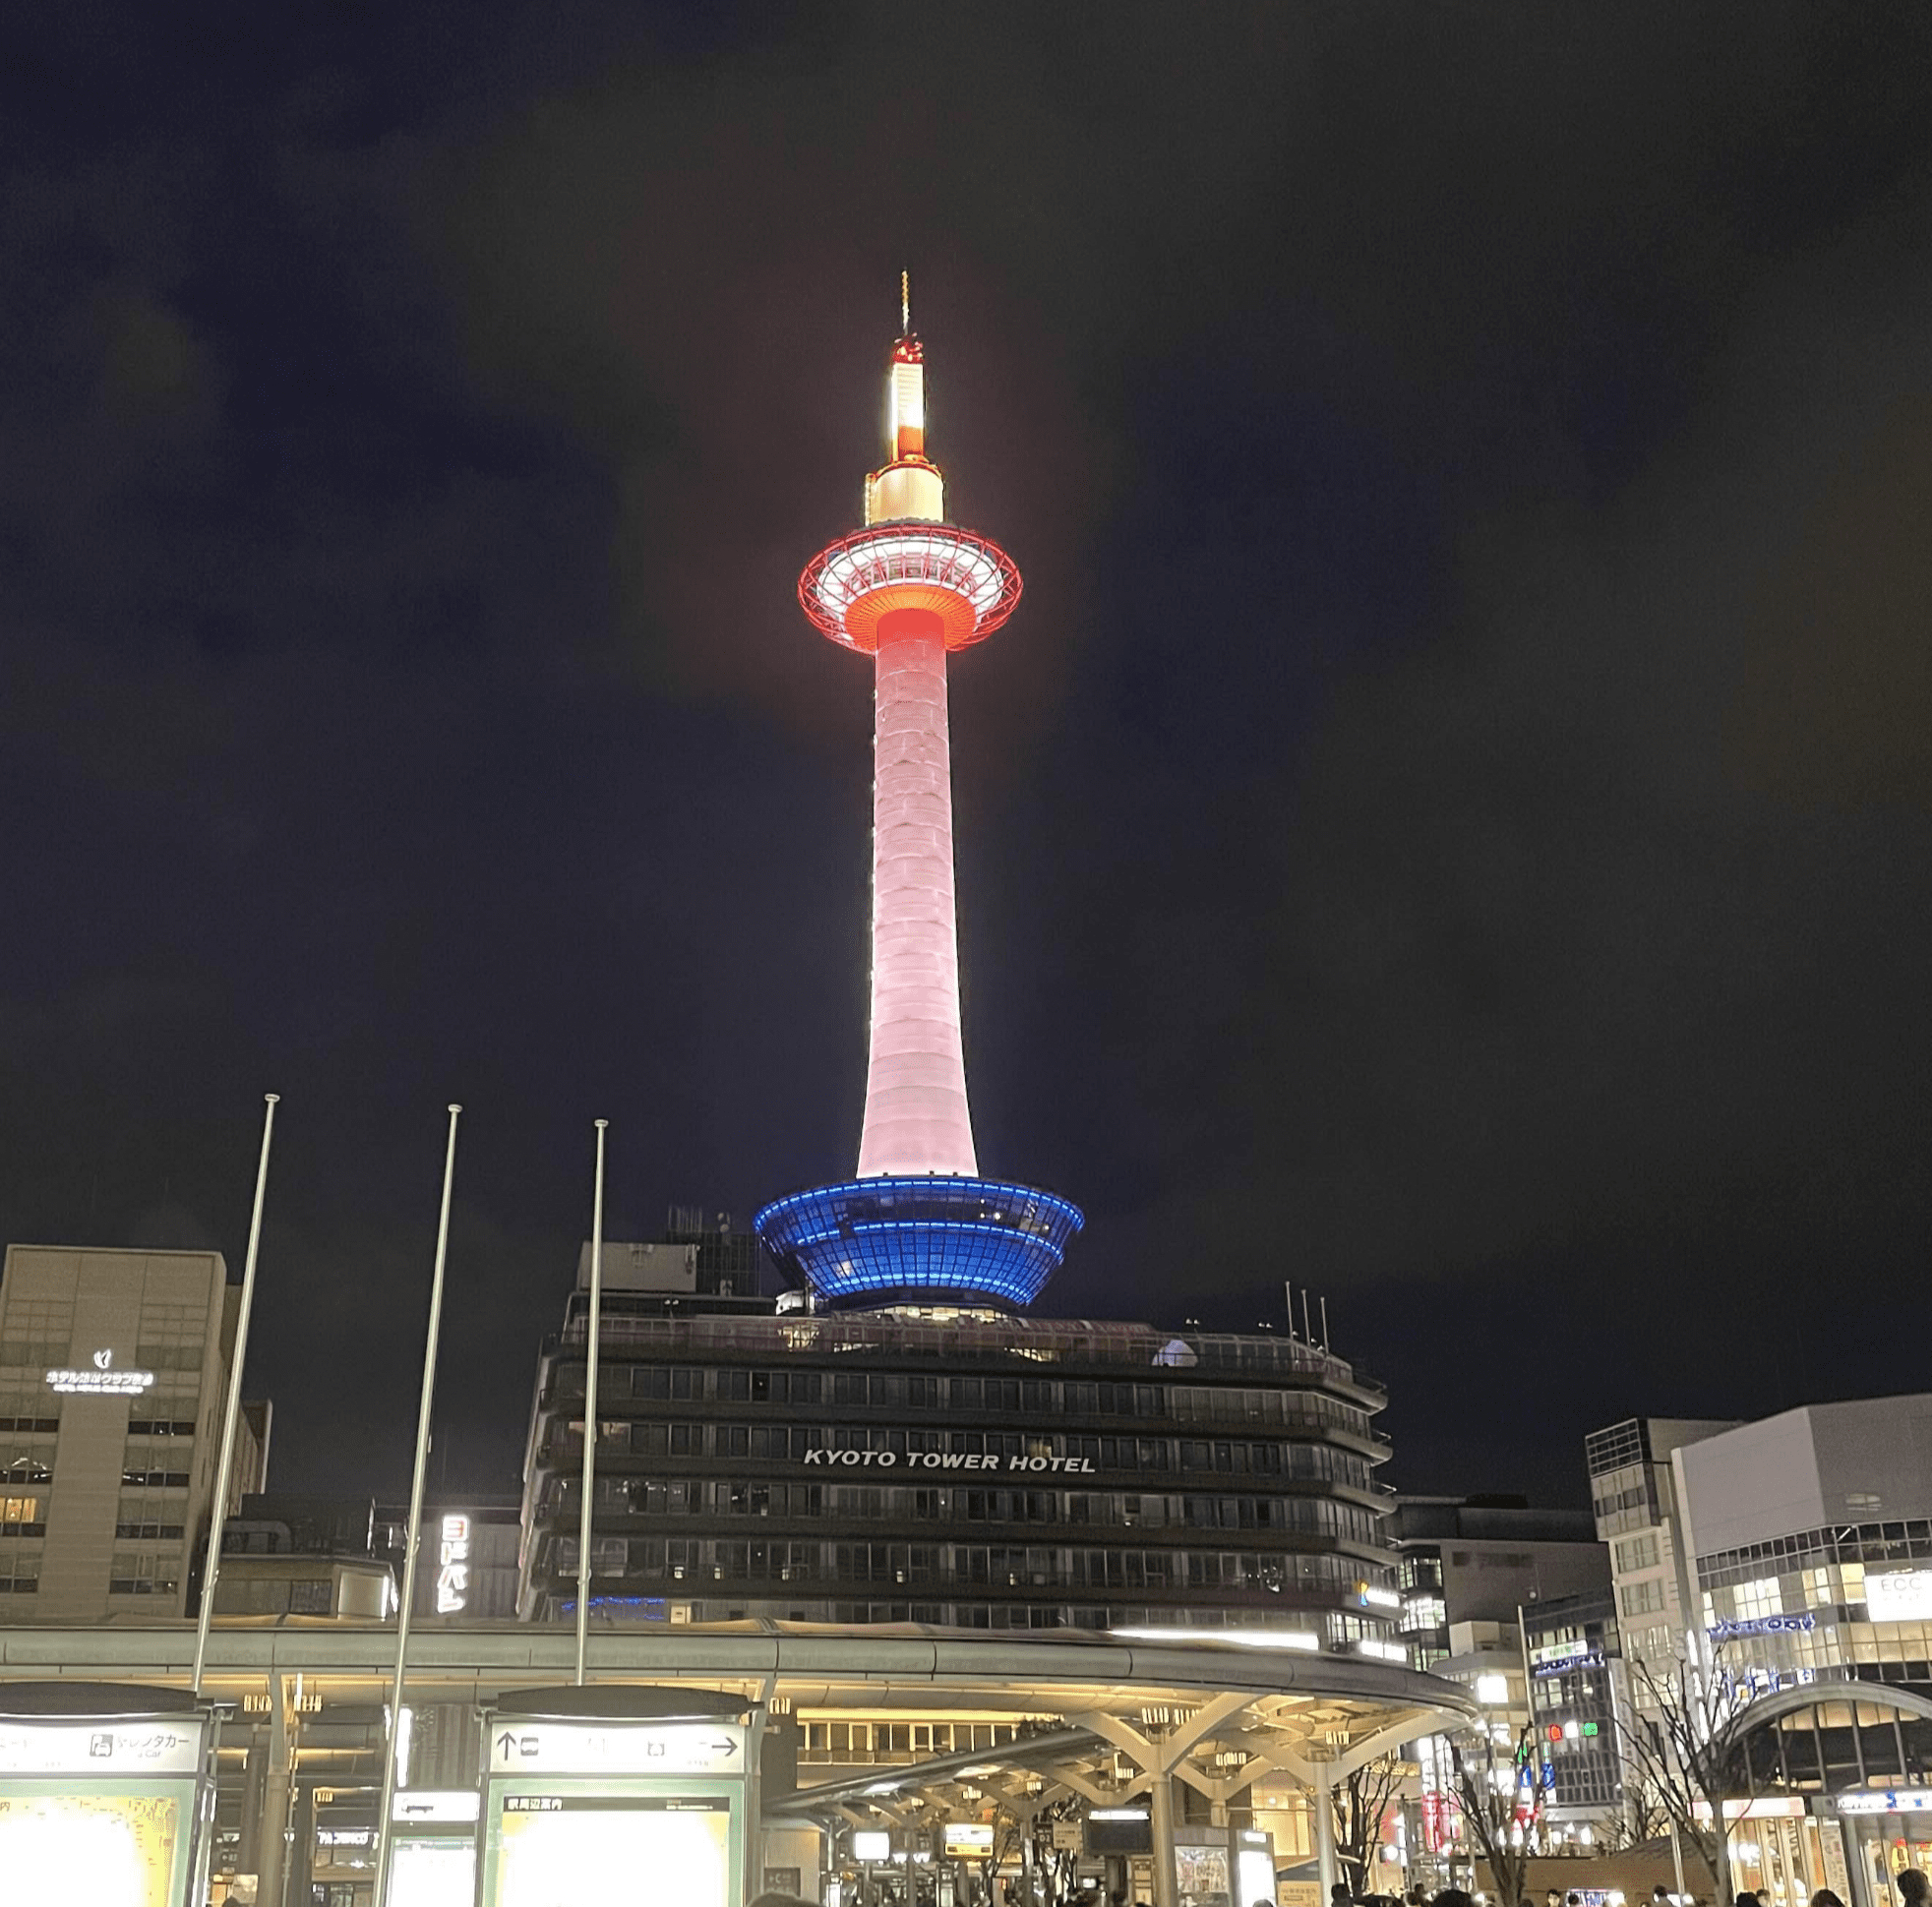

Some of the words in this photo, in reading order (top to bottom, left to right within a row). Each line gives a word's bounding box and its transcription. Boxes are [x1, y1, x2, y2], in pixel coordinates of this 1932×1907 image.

[803, 1450, 897, 1466] KYOTO
[906, 1452, 999, 1470] TOWER
[1009, 1456, 1096, 1473] HOTEL
[437, 1516, 468, 1613] ヨドバシ
[1881, 1578, 1922, 1591] ECC
